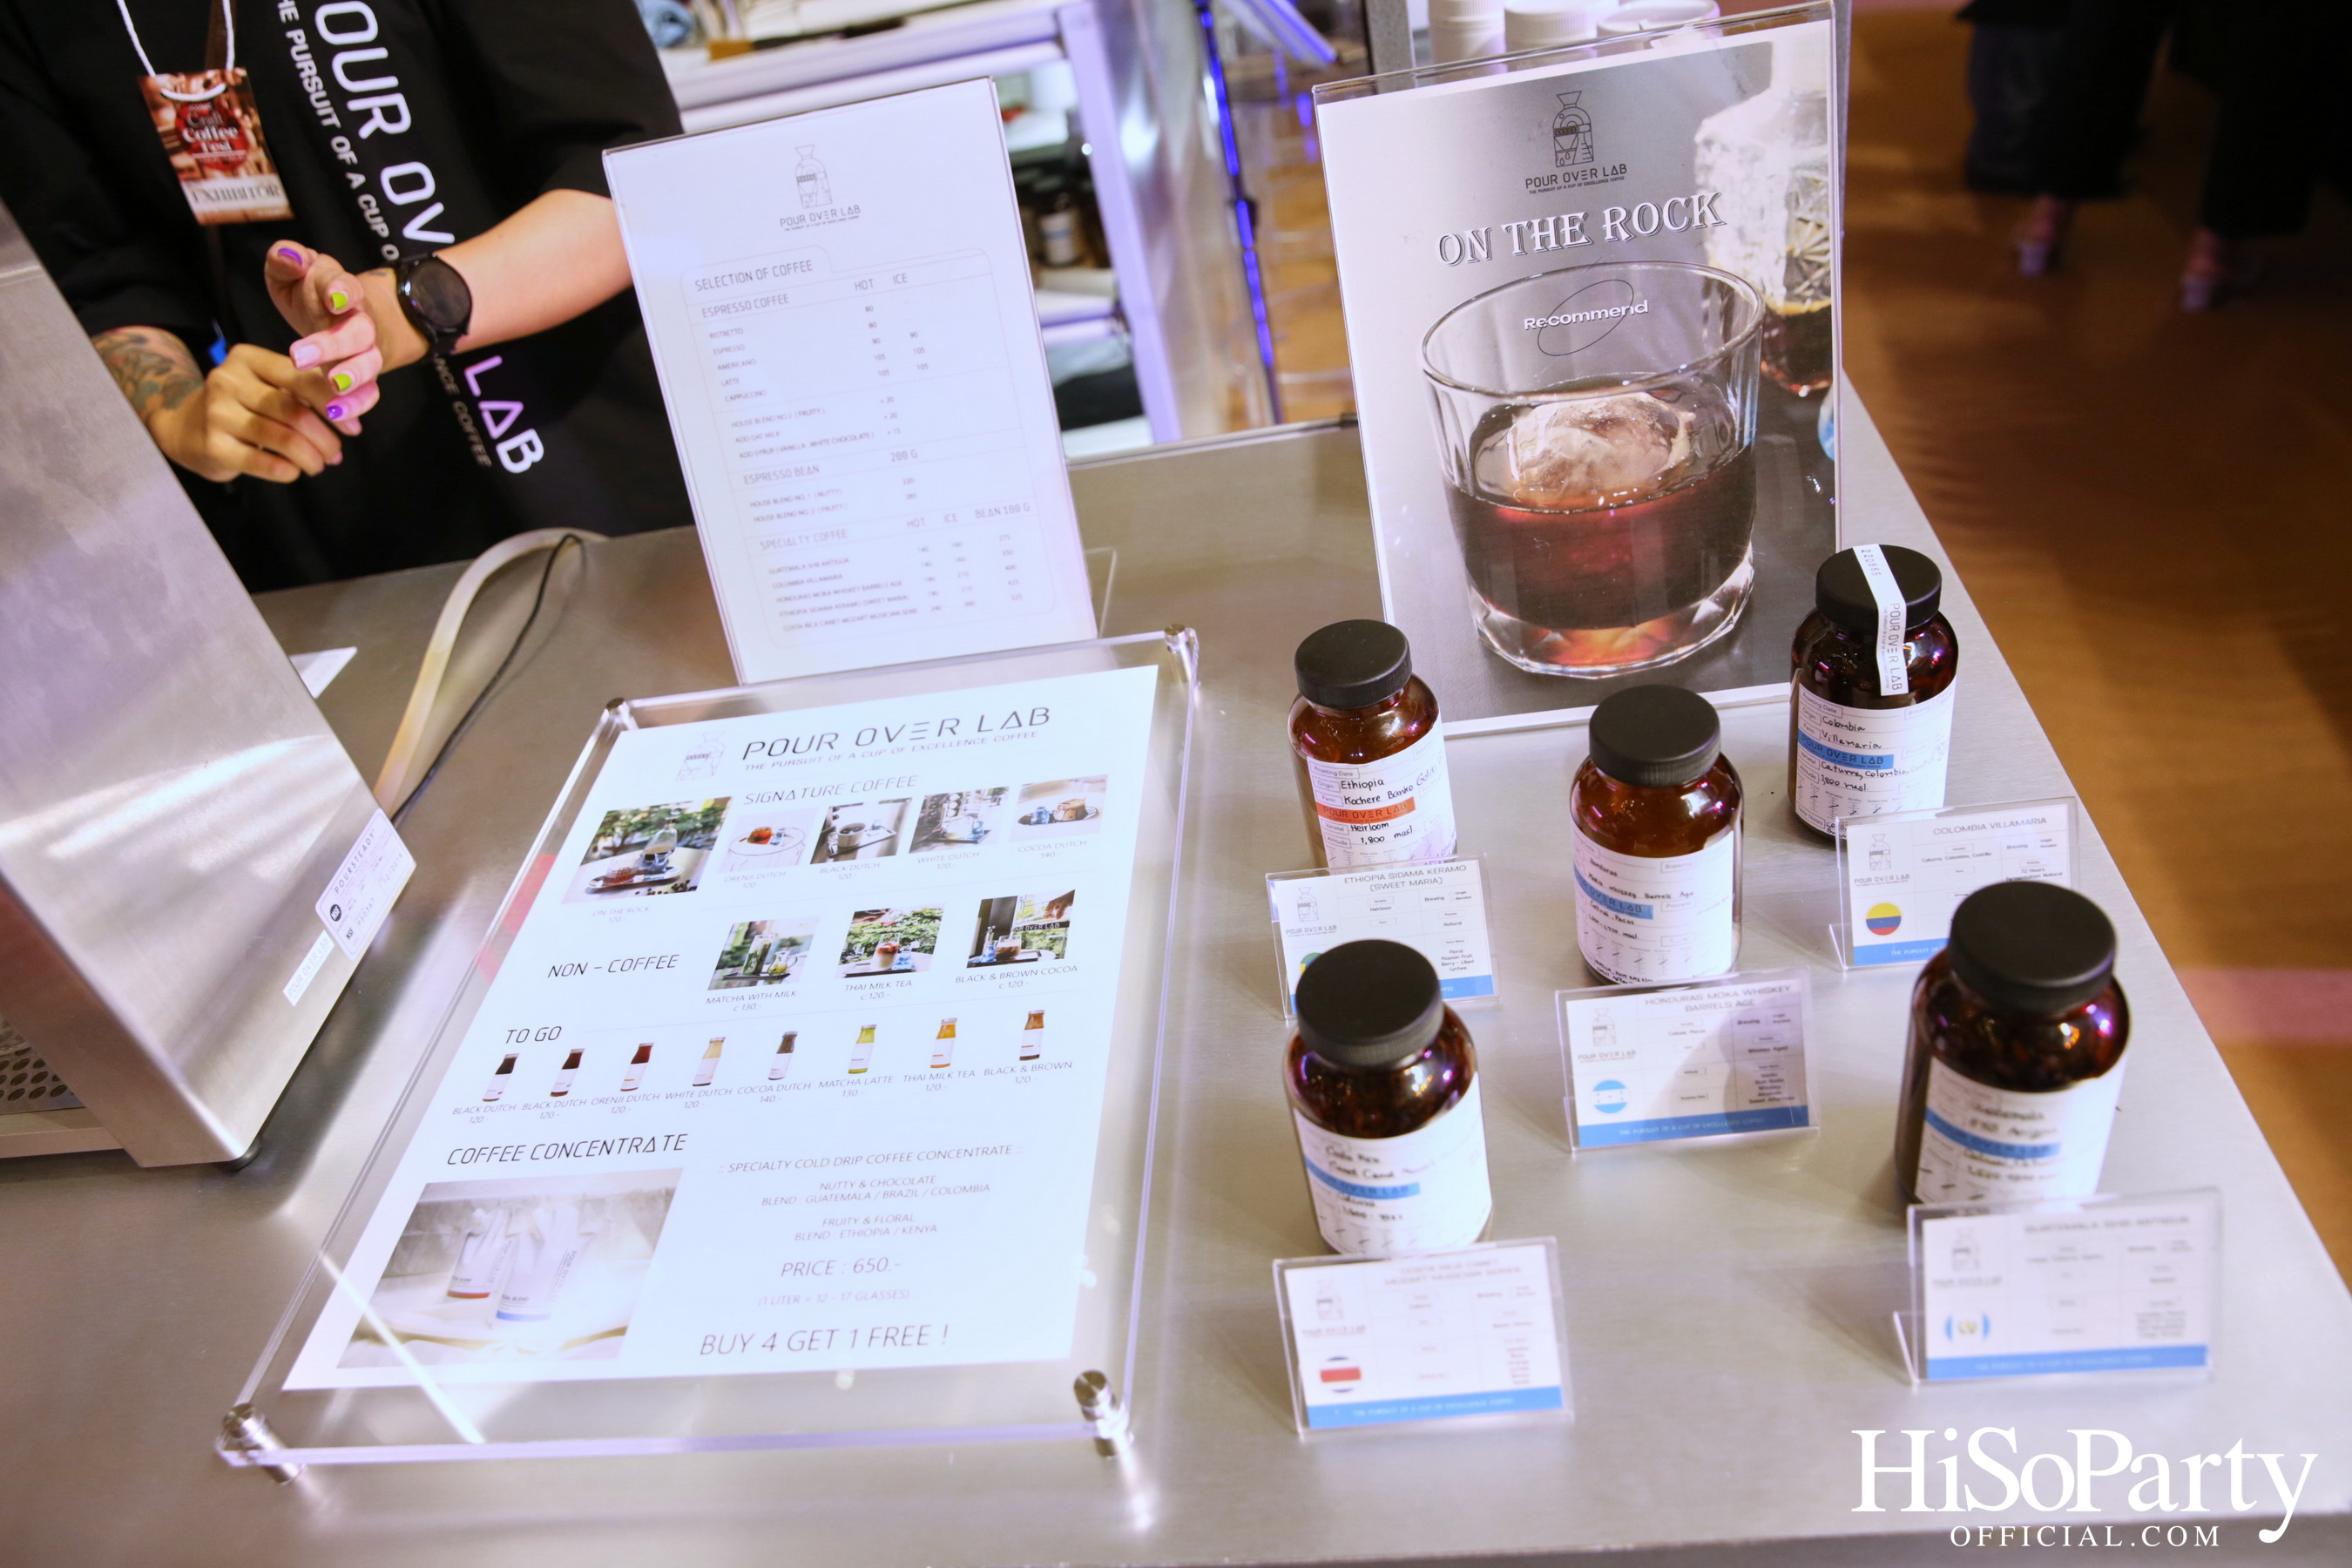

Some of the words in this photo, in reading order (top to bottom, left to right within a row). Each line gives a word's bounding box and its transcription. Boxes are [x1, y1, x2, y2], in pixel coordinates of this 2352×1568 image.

[182, 125, 240, 144] Coffee
[285, 28, 342, 130] PURSUIT
[329, 135, 358, 166] OF
[345, 171, 366, 190] A
[357, 193, 390, 239] CUP
[1525, 175, 1558, 189] POUR
[1563, 168, 1598, 183] OVER
[1603, 163, 1627, 177] LAB
[191, 184, 282, 205] EXHIBITOR
[780, 213, 807, 227] POUR
[808, 208, 837, 221] OVER
[841, 204, 862, 217] LAB
[1436, 226, 1493, 267] ON
[1500, 211, 1593, 257] THE
[1601, 191, 1727, 244] ROCK
[694, 271, 754, 292] SELECTION
[755, 267, 770, 281] OF
[772, 260, 814, 278] COFFEE
[701, 301, 753, 319] ESPRESSO
[754, 293, 790, 309] COFFEE
[854, 279, 875, 292] HOT
[892, 273, 909, 285] ICE
[1524, 300, 1649, 330] Recommend
[709, 328, 745, 340] RISTRETTO
[713, 343, 746, 355] ESPRESSO
[717, 358, 757, 371] AMERICANO
[721, 377, 740, 387] LATTE
[725, 389, 767, 402] CAPPUCCINO
[463, 355, 544, 474] LAB
[743, 467, 793, 485] ESPRESSO
[794, 464, 821, 478] BEAN
[910, 449, 918, 459] G
[760, 534, 810, 551] SPECIALTY
[814, 528, 848, 543] COFFEE
[907, 517, 926, 529] HOT
[943, 512, 958, 524] ICE
[975, 506, 1002, 519] BEAN
[1023, 502, 1031, 512] G
[1889, 603, 1901, 632] POUR
[1888, 634, 1899, 663] OVER
[1890, 667, 1903, 691] LAB
[742, 732, 840, 760] POUR
[855, 718, 961, 747] OVER
[977, 706, 1051, 733] LAB
[1822, 715, 1865, 732] Colombia
[1821, 729, 1882, 749] Villamaria
[745, 763, 766, 772] THE
[771, 756, 822, 769] PURSUIT
[828, 754, 844, 763] OF
[862, 748, 886, 759] CUP
[891, 746, 907, 754] OF
[911, 736, 989, 753] EXCELLENCE
[993, 730, 1038, 744] COFFEE
[1828, 748, 1856, 762] OVER
[1861, 756, 1884, 765] LAB
[744, 782, 845, 806] SIGNATURE
[850, 775, 918, 794] COFFEE
[1341, 777, 1384, 791] Ethiopia
[1387, 785, 1414, 800] Banko
[1322, 806, 1348, 818] POUR
[1352, 809, 1383, 819] OVER
[1386, 802, 1408, 815] LAB
[1351, 821, 1389, 832] Heirloom
[1361, 835, 1385, 845] 1,800
[1394, 825, 1413, 839] masl
[1933, 823, 1987, 836] COLOMBIA
[1990, 817, 2047, 830] VILLAMARIA
[334, 828, 375, 896] POURSTEADY
[1344, 874, 1386, 884] ETHIOPIA
[1389, 869, 1424, 880] SIDAMA
[1427, 864, 1467, 875] KERAMO
[1370, 882, 1405, 892] (SWEET
[1409, 876, 1443, 887] MARIA)
[1620, 901, 1643, 913] LAB
[547, 962, 589, 979] NON
[608, 954, 680, 974] COFFEE
[956, 973, 987, 983] BLACK
[989, 972, 997, 981] &
[999, 970, 1038, 980] BROWN
[1040, 964, 1078, 976] COCOA
[845, 983, 867, 993] THAI
[868, 981, 893, 991] MILK
[895, 979, 912, 988] TEA
[1646, 994, 1704, 1006] HONDURAS
[1707, 990, 1740, 1000] MOKA
[1742, 984, 1791, 997] WHISKEY
[705, 994, 745, 1005] MATCHA
[747, 991, 773, 1001] WITH
[774, 990, 798, 999] MILK
[1686, 1002, 1733, 1012] BARRELS
[1735, 998, 1754, 1007] AGE
[505, 1028, 531, 1044] TO
[534, 1025, 562, 1042] GO
[903, 1073, 927, 1083] THAI
[929, 1071, 954, 1081] MILK
[956, 1069, 976, 1078] TEA
[983, 1066, 1017, 1077] BLACK
[1031, 1060, 1073, 1071] BROWN
[737, 1085, 774, 1095] COCOA
[776, 1082, 812, 1092] DUTCH
[818, 1078, 862, 1089] MATCHA
[863, 1075, 895, 1085] LATTE
[591, 1096, 626, 1106] ORENJI
[627, 1092, 661, 1103] DUTCH
[665, 1091, 696, 1100] WHITE
[698, 1088, 733, 1098] DUTCH
[452, 1105, 481, 1115] BLACK
[483, 1104, 517, 1113] DUTCH
[522, 1101, 551, 1111] BLACK
[553, 1098, 587, 1109] DUTCH
[447, 1144, 528, 1166] COFFEE
[531, 1133, 688, 1160] CONCENTRATE
[727, 1159, 792, 1173] SPECIALTY
[794, 1158, 830, 1169] COLD
[833, 1155, 863, 1167] DRIP
[866, 1152, 914, 1164] COFFEE
[916, 1145, 1013, 1161] CONCENTRATE
[820, 1180, 856, 1192] NUTTY
[858, 1179, 867, 1187] &
[869, 1175, 937, 1187] CHOCOLATE
[761, 1195, 798, 1206] BLEND
[805, 1191, 872, 1204] GUATEMALA
[882, 1189, 920, 1200] BRAZIL
[930, 1184, 990, 1196] COLOMBIA
[822, 1215, 861, 1227] FRUITY
[862, 1214, 871, 1224] &
[874, 1213, 916, 1224] FLORAL
[794, 1231, 831, 1241] BLEND
[839, 1227, 890, 1240] ETHIOPIA
[901, 1223, 938, 1235] KENYA
[781, 1260, 836, 1278] PRICE
[853, 1256, 902, 1274] 650.-
[700, 1332, 756, 1355] BUY
[761, 1332, 778, 1352] 4
[787, 1328, 841, 1352] GET
[849, 1328, 860, 1348] 1
[868, 1324, 933, 1348] FREE
